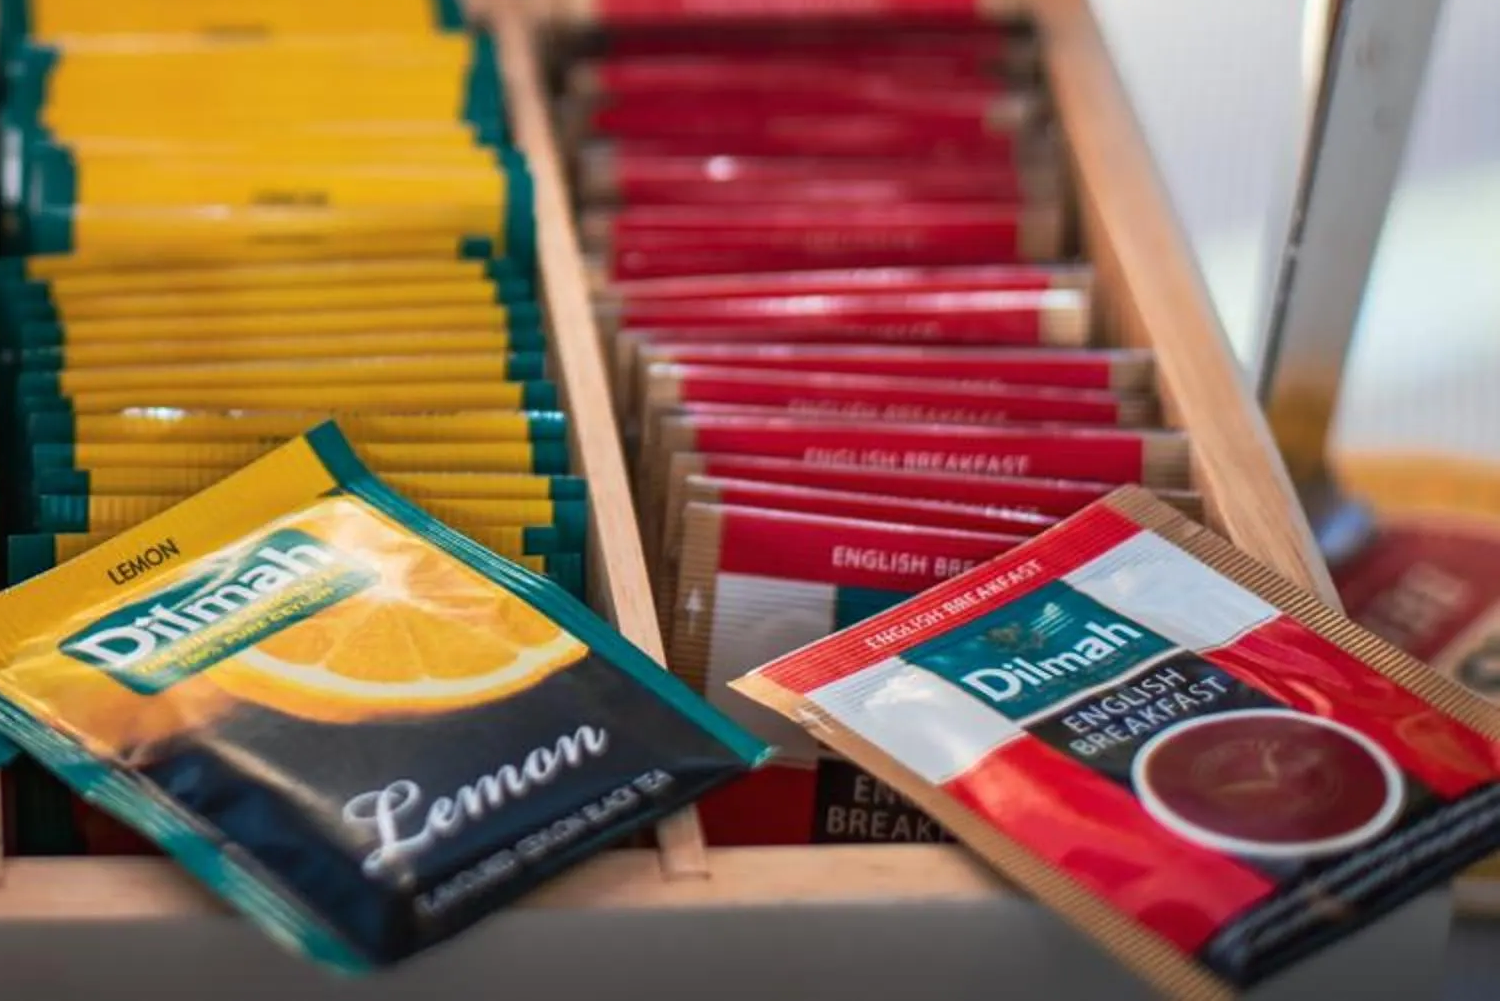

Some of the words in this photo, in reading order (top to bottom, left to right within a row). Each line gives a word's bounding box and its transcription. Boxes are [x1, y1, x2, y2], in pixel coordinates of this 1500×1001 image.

[803, 446, 899, 469] ENGLISH
[902, 451, 1030, 476] BREAKFAST
[107, 538, 181, 586] LEMON
[831, 545, 928, 576] ENGLISH
[70, 543, 335, 668] Dilmah
[865, 607, 945, 650] ENGLISH
[942, 559, 1044, 616] BREAKFAST
[960, 620, 1143, 702] Dilmah
[1062, 667, 1188, 734] ENGLISH
[1069, 675, 1230, 756] BREAKFAST
[342, 724, 608, 882] Lemon
[632, 768, 675, 792] TEA
[826, 804, 947, 842] BREAK
